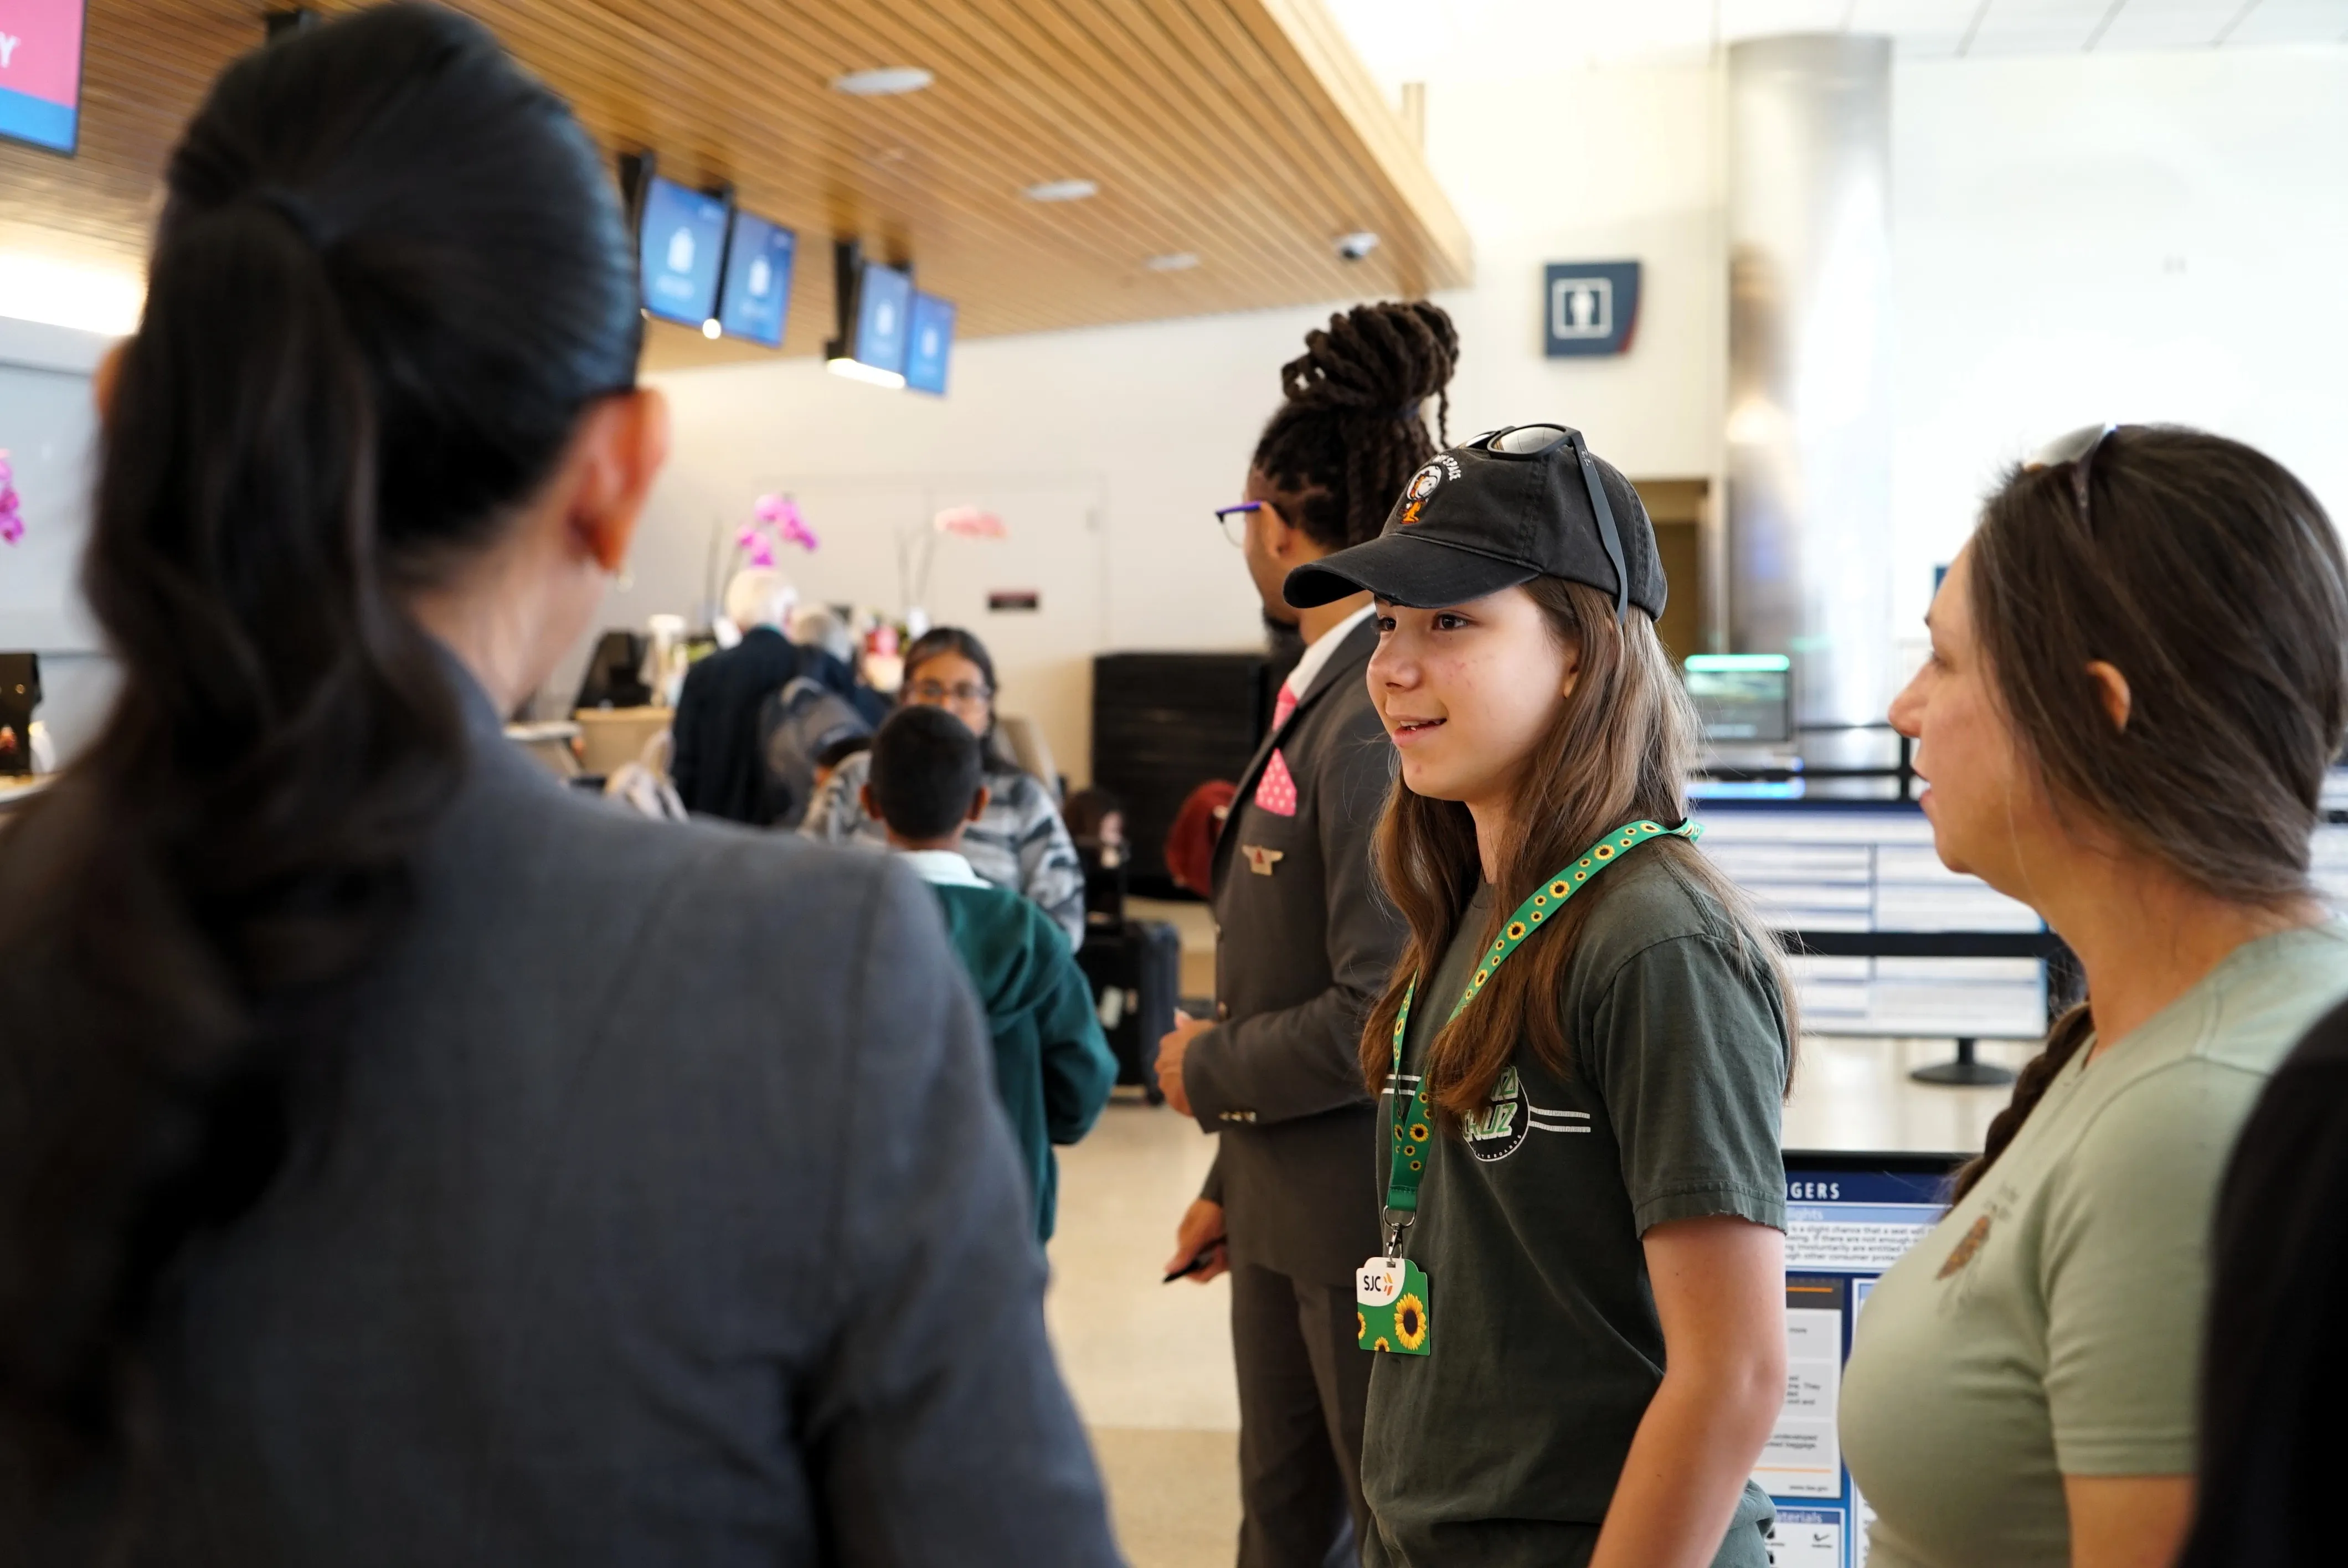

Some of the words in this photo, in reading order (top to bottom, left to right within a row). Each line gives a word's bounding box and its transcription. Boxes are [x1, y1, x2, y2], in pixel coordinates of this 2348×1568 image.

[1474, 1134, 1521, 1159] ATEBOARDS
[1790, 1182, 1840, 1200] GERS
[1363, 1275, 1381, 1292] SJC
